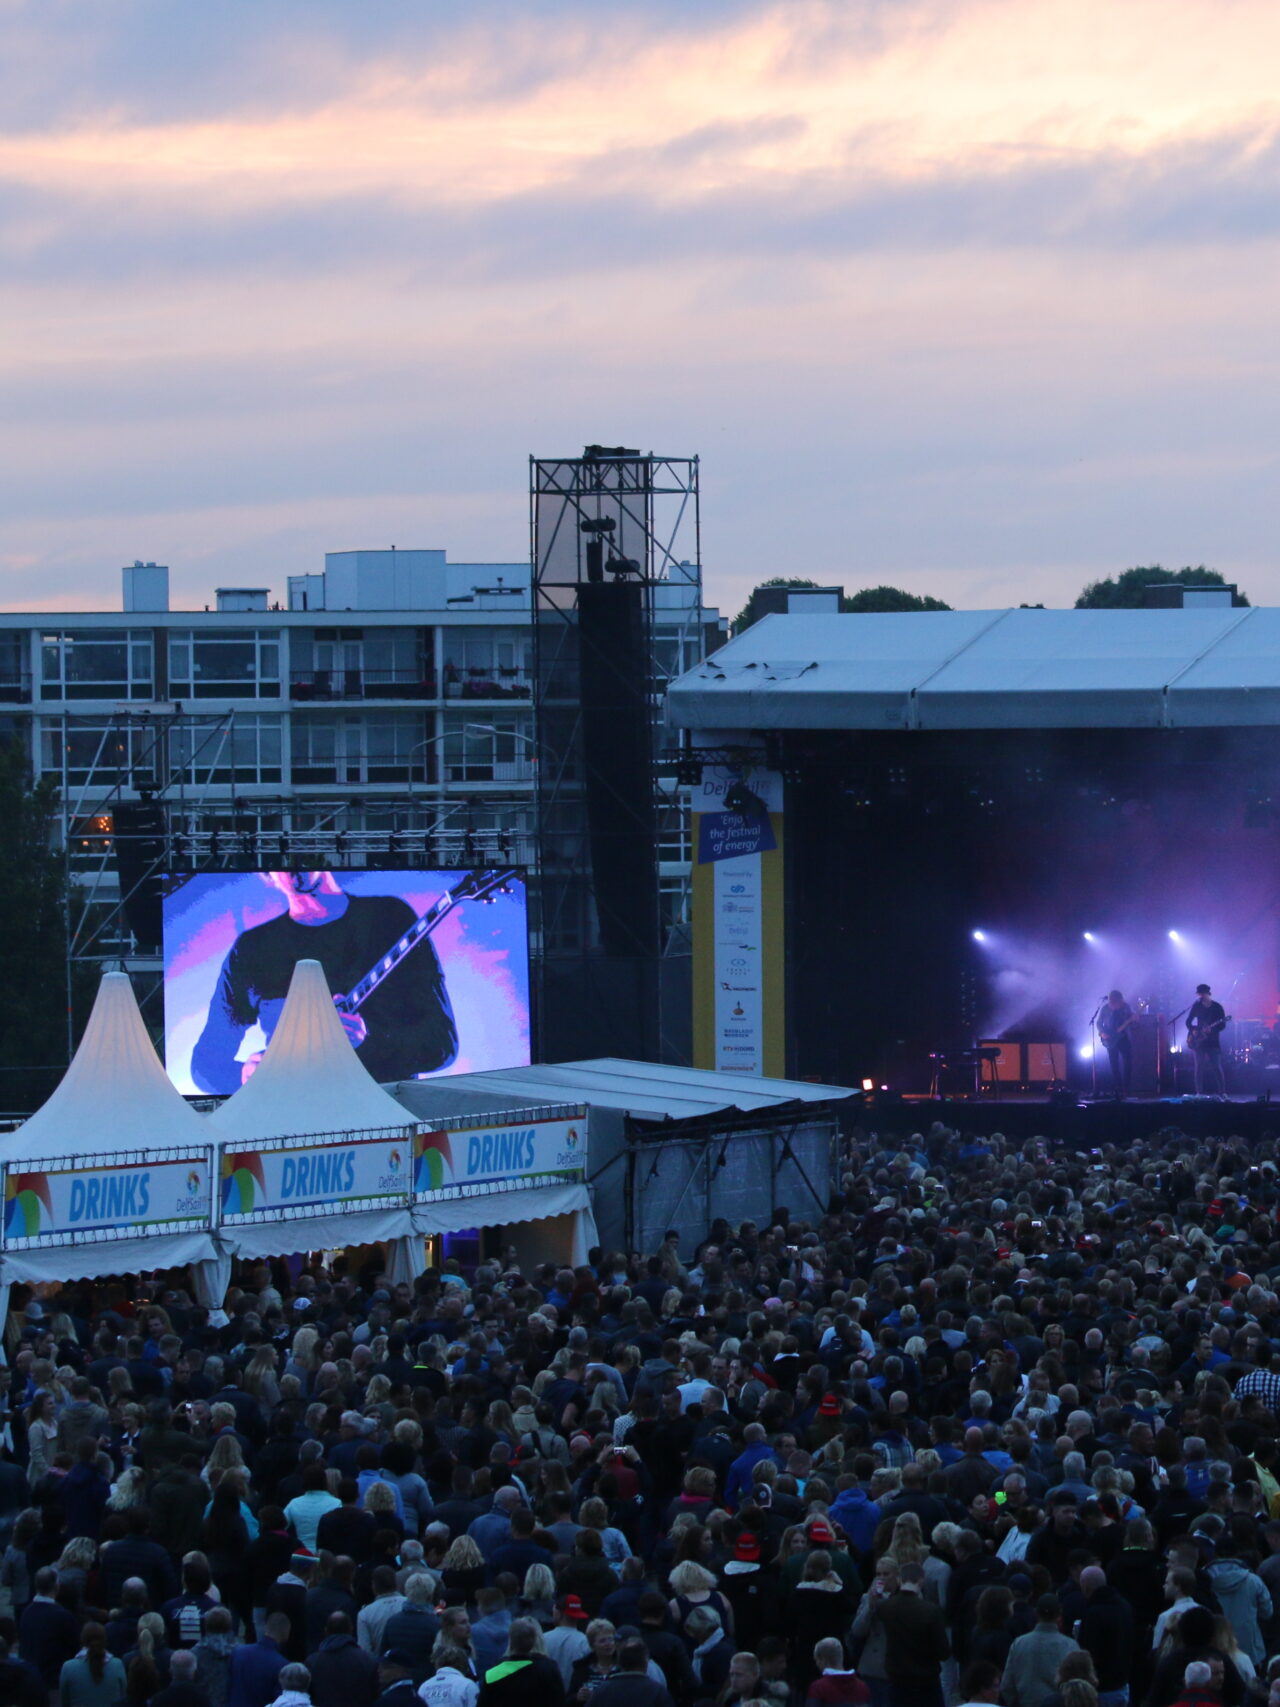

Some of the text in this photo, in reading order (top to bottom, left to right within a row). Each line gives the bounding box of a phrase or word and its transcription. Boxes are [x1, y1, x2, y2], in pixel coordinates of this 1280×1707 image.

[709, 825, 760, 840] the festival
[713, 840, 724, 855] of
[281, 1150, 355, 1199] DRINKS
[467, 1129, 536, 1176] DRINKS
[70, 1172, 150, 1222] DRINKS
